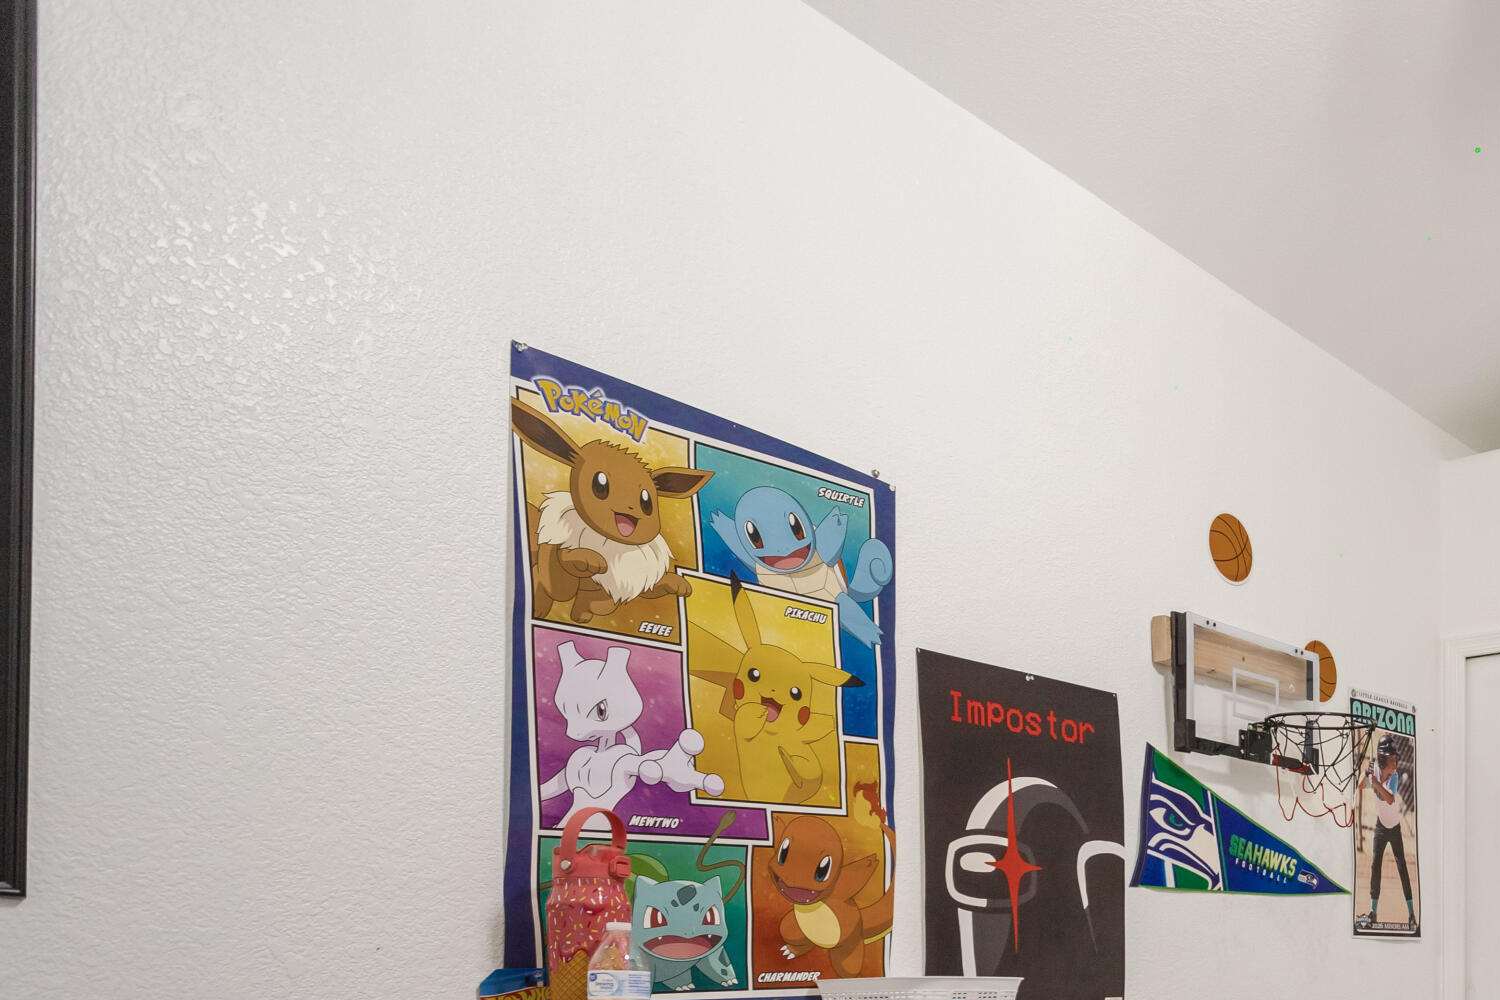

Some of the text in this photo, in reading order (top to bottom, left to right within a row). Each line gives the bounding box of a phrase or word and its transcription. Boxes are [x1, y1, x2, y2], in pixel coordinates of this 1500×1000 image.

[533, 376, 649, 442] Pokémon
[818, 487, 865, 507] SQUIRTLE
[784, 606, 828, 624] PIKACHU
[638, 621, 673, 637] EEVEE
[950, 690, 1095, 744] Impostor
[1352, 700, 1415, 735] ARIZONA
[629, 815, 680, 829] MEWTWO
[1229, 834, 1298, 877] SEAHAWKS
[757, 971, 821, 983] CHARMANDER
